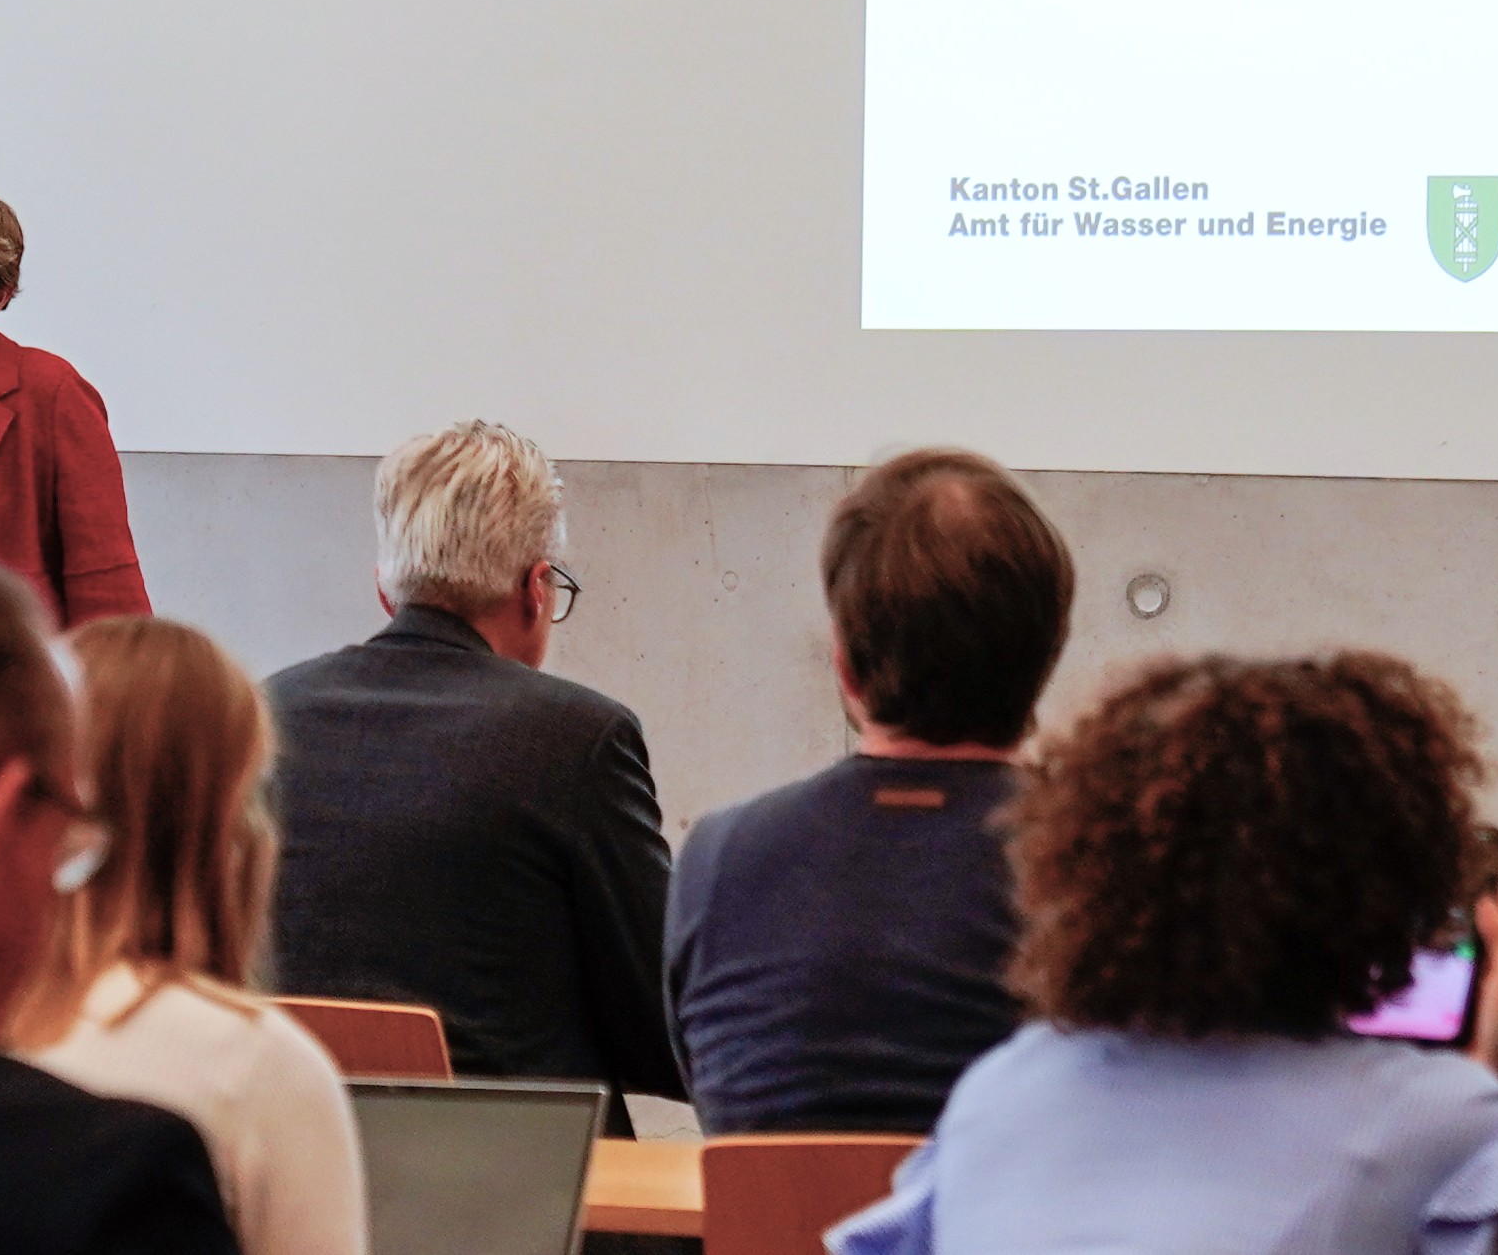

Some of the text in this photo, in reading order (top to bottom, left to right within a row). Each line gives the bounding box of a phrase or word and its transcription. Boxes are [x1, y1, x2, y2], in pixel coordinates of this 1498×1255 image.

[949, 176, 1059, 202] Kanton
[947, 210, 1388, 243] Amt für Wasser und Energie
